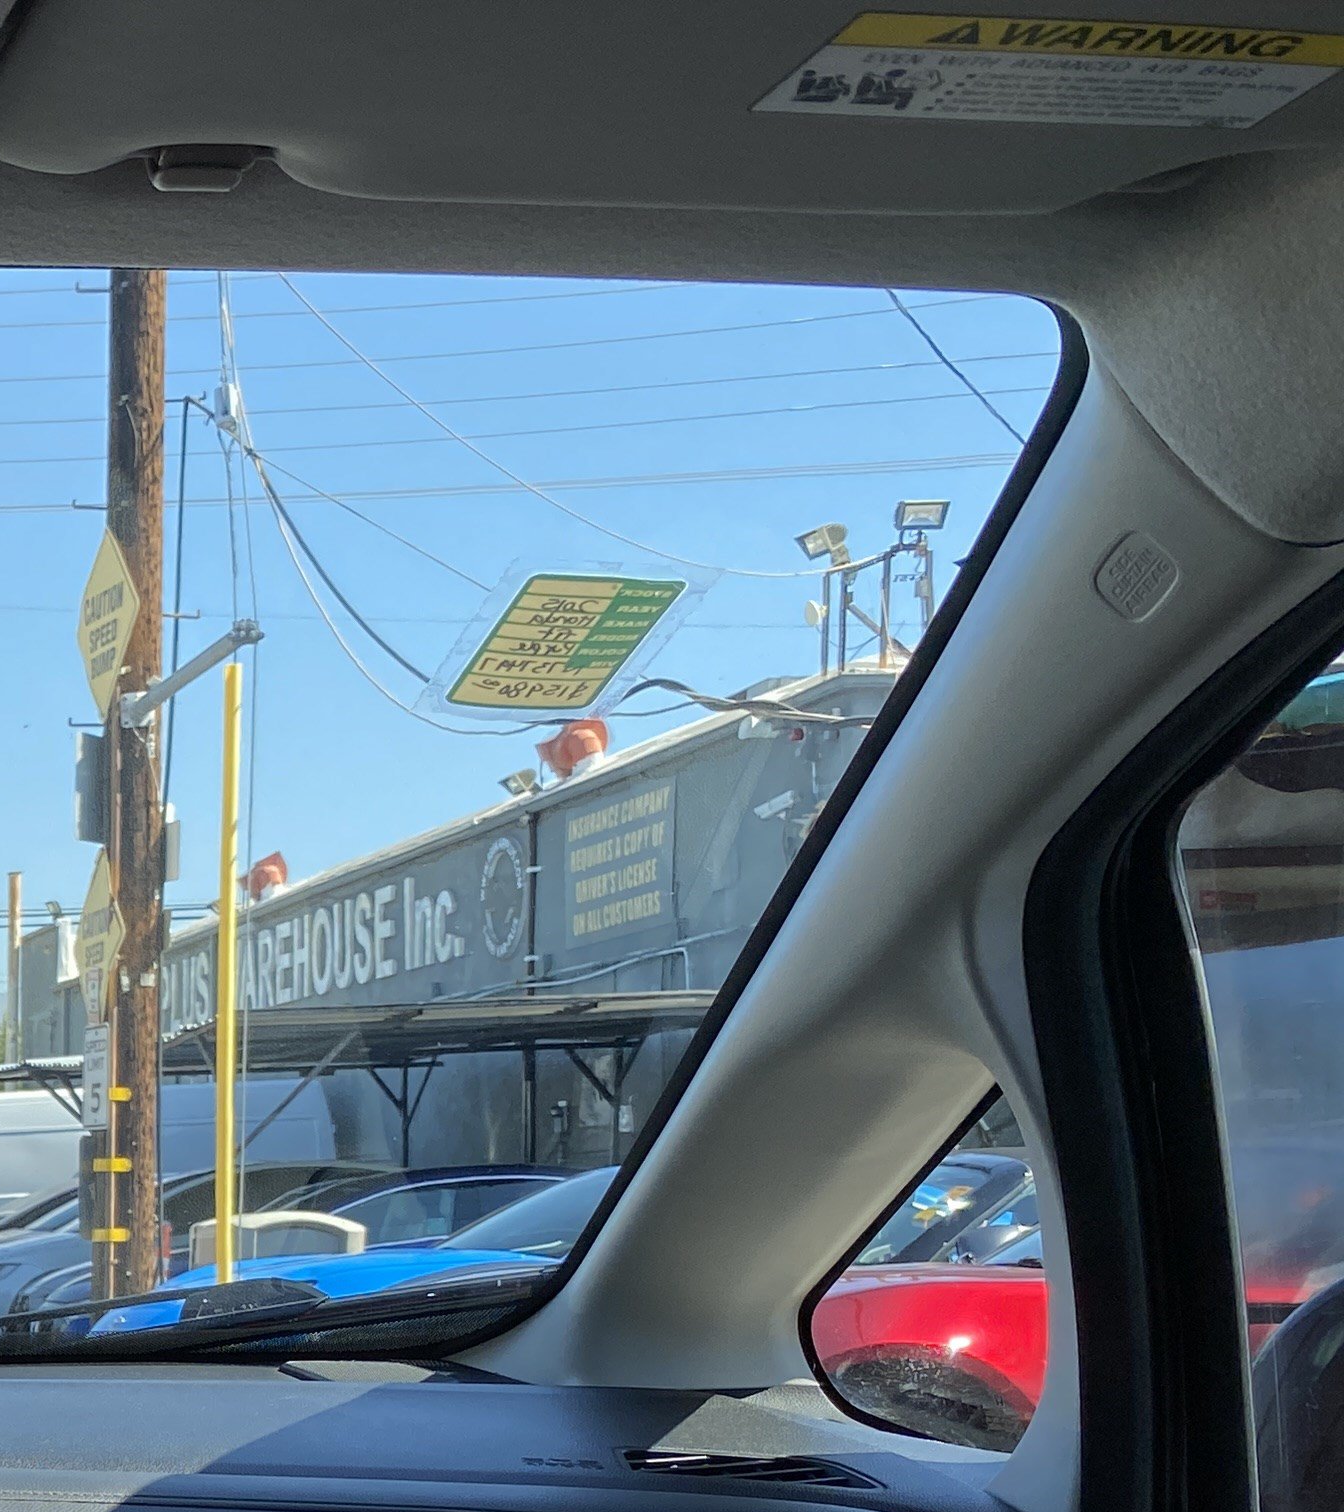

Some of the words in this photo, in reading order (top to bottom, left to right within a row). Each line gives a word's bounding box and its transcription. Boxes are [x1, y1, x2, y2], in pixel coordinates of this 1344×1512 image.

[997, 24, 1305, 58] WARNING
[84, 581, 124, 626] CAUTION
[89, 618, 118, 653] SPEED
[568, 806, 619, 843] INSURANCE
[621, 785, 671, 825] COMPANY
[570, 838, 613, 874] REQUIRES
[624, 827, 650, 857] COPY
[651, 820, 665, 848] OF
[618, 858, 658, 892] LICENSE
[573, 913, 585, 937] ON
[587, 906, 602, 932] ALL
[603, 890, 661, 927] CUSTOMERS
[237, 884, 397, 1010] AREHOUSE
[403, 877, 468, 970] Inc.
[89, 1083, 103, 1115] 5
